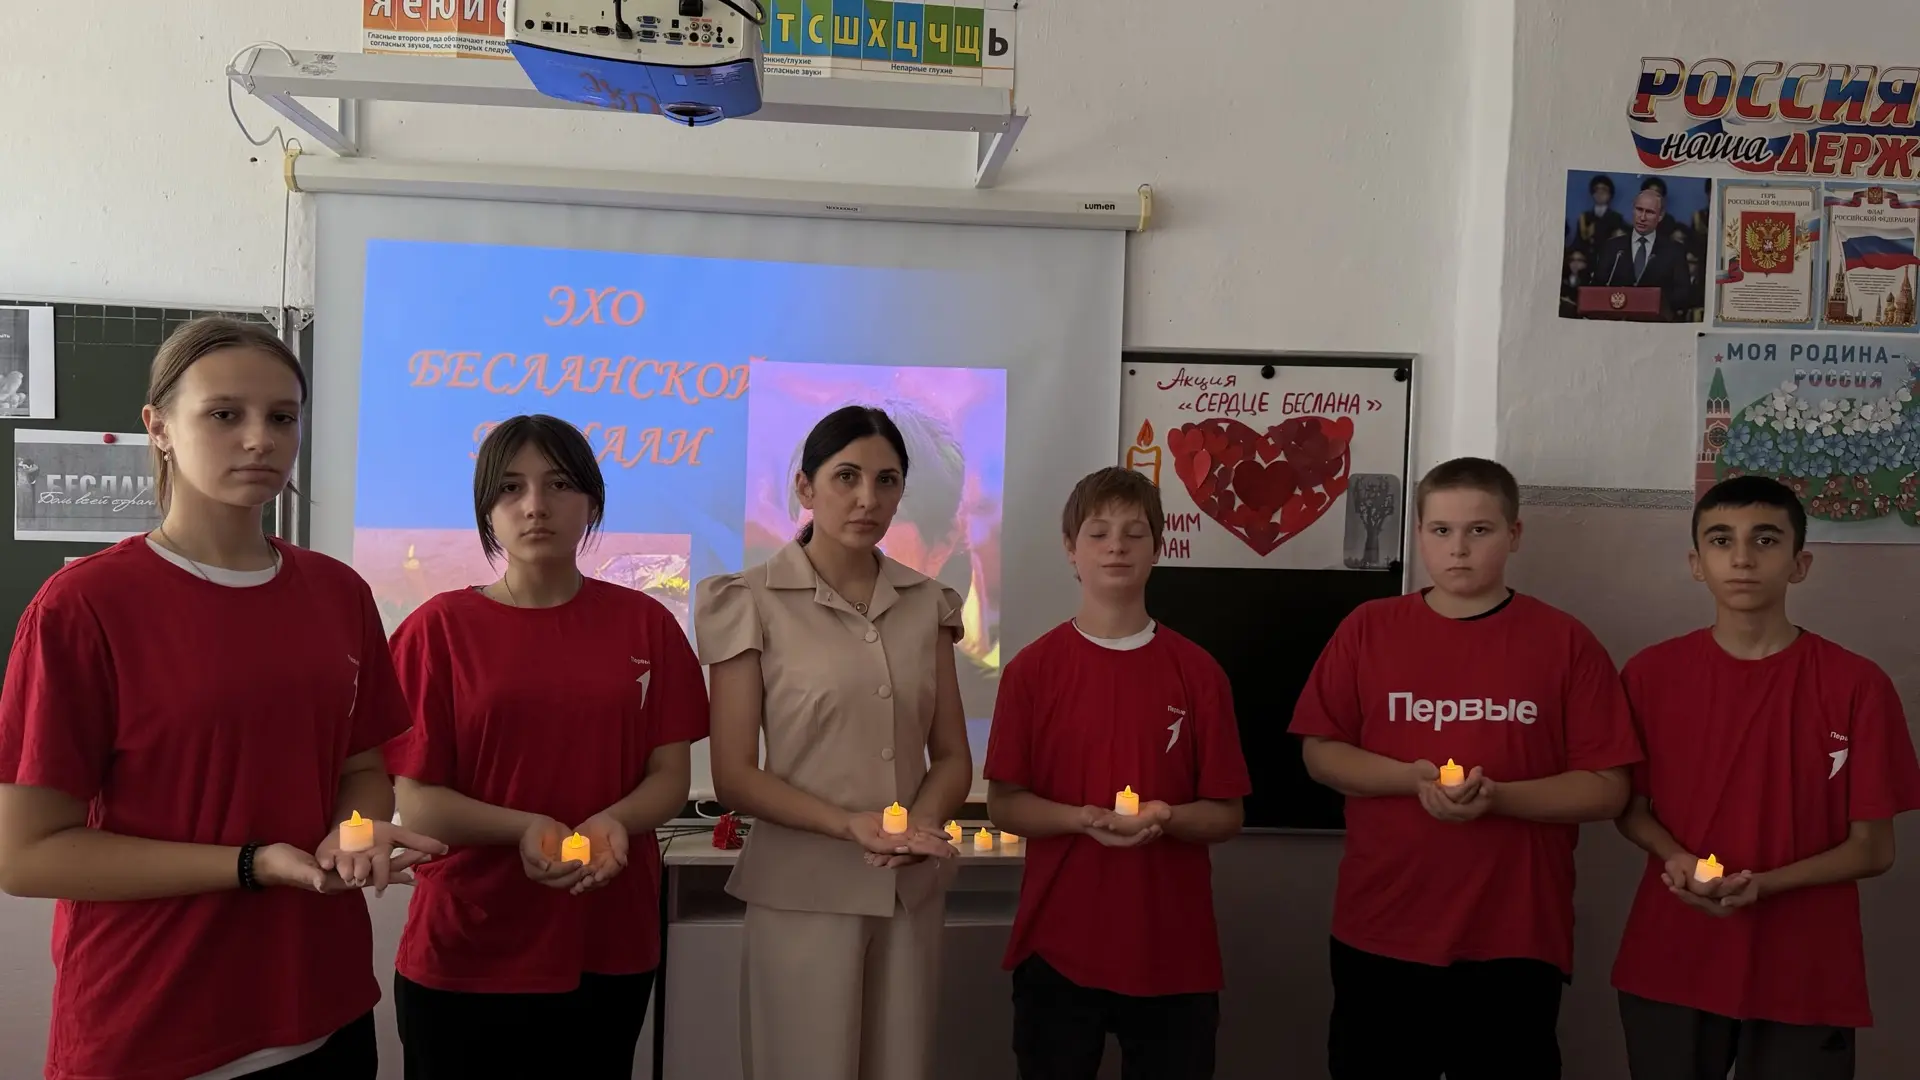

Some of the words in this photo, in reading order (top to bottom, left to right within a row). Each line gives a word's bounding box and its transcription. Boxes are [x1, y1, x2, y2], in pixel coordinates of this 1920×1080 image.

[367, 31, 397, 40] Гласные
[398, 35, 425, 43] второго
[426, 36, 442, 44] ряда
[443, 35, 484, 44] обозначают
[370, 40, 406, 49] согласных
[407, 42, 432, 50] звуков,
[453, 44, 483, 53] которых
[801, 69, 822, 77] звуки
[890, 63, 928, 74] Непарные
[928, 67, 953, 76] глухие
[1630, 56, 1920, 127] РОССИЯ
[1661, 131, 1774, 163] наша
[1774, 131, 1920, 177] ДЕРЖ
[1834, 214, 1877, 222] РОССИЙСКОЙ
[544, 285, 646, 327] ЭХО
[1726, 342, 1777, 362] МОЯ
[1157, 367, 1237, 391] Акция
[1793, 368, 1883, 389] РОССИЯ
[111, 487, 155, 513] стран
[1388, 692, 1538, 731] Первые
